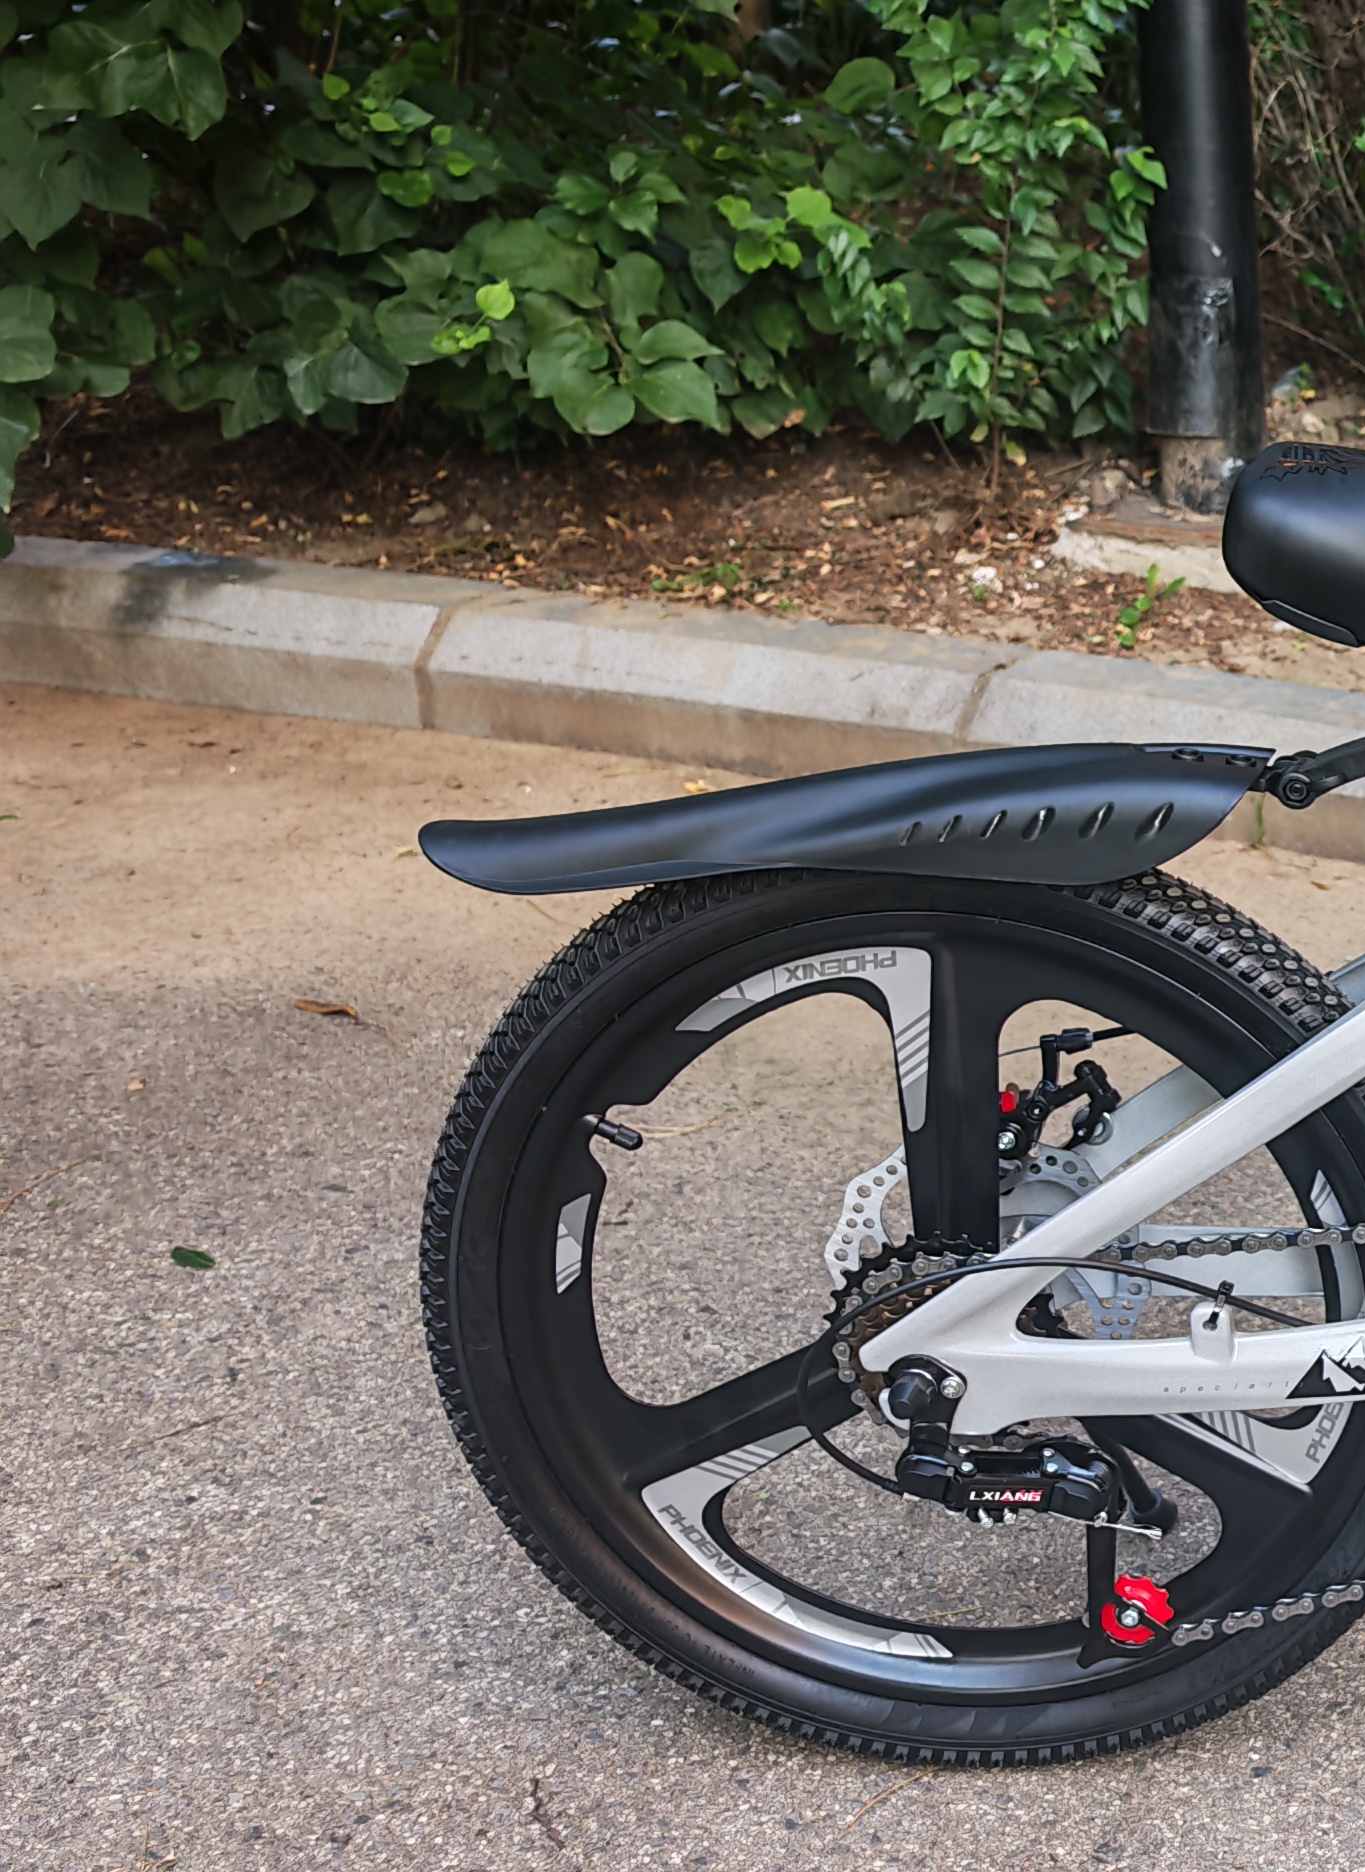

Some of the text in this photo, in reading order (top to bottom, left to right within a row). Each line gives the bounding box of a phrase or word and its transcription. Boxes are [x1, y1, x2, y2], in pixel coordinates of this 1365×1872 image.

[783, 950, 897, 984] PHOENIX
[1305, 1402, 1345, 1464] PHOE
[969, 1490, 1043, 1502] LXIANG
[656, 1503, 748, 1585] PHOENIX
